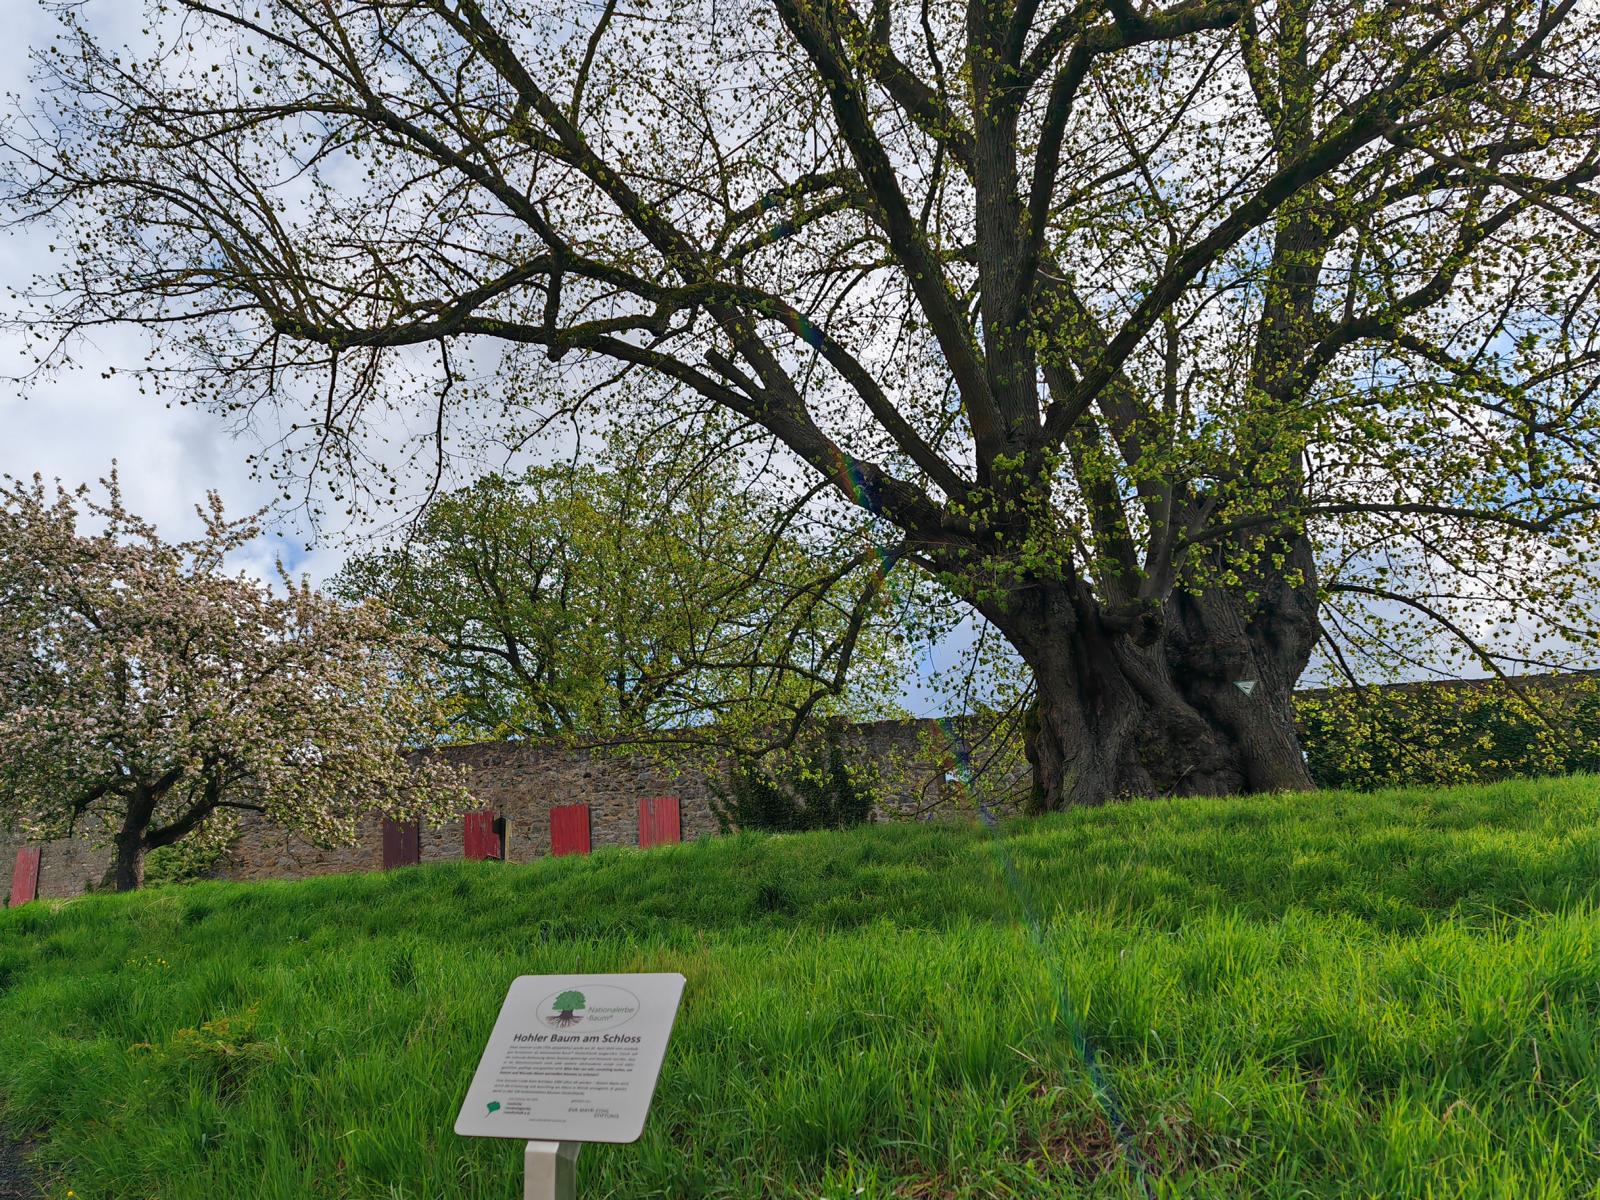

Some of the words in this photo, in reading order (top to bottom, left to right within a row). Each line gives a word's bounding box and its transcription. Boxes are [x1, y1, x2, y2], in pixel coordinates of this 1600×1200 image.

[588, 1006, 634, 1014] Nationalerbe
[513, 1033, 549, 1043] Hohler
[550, 1033, 580, 1043] Baum
[583, 1035, 600, 1043] am
[602, 1033, 641, 1044] Schloss
